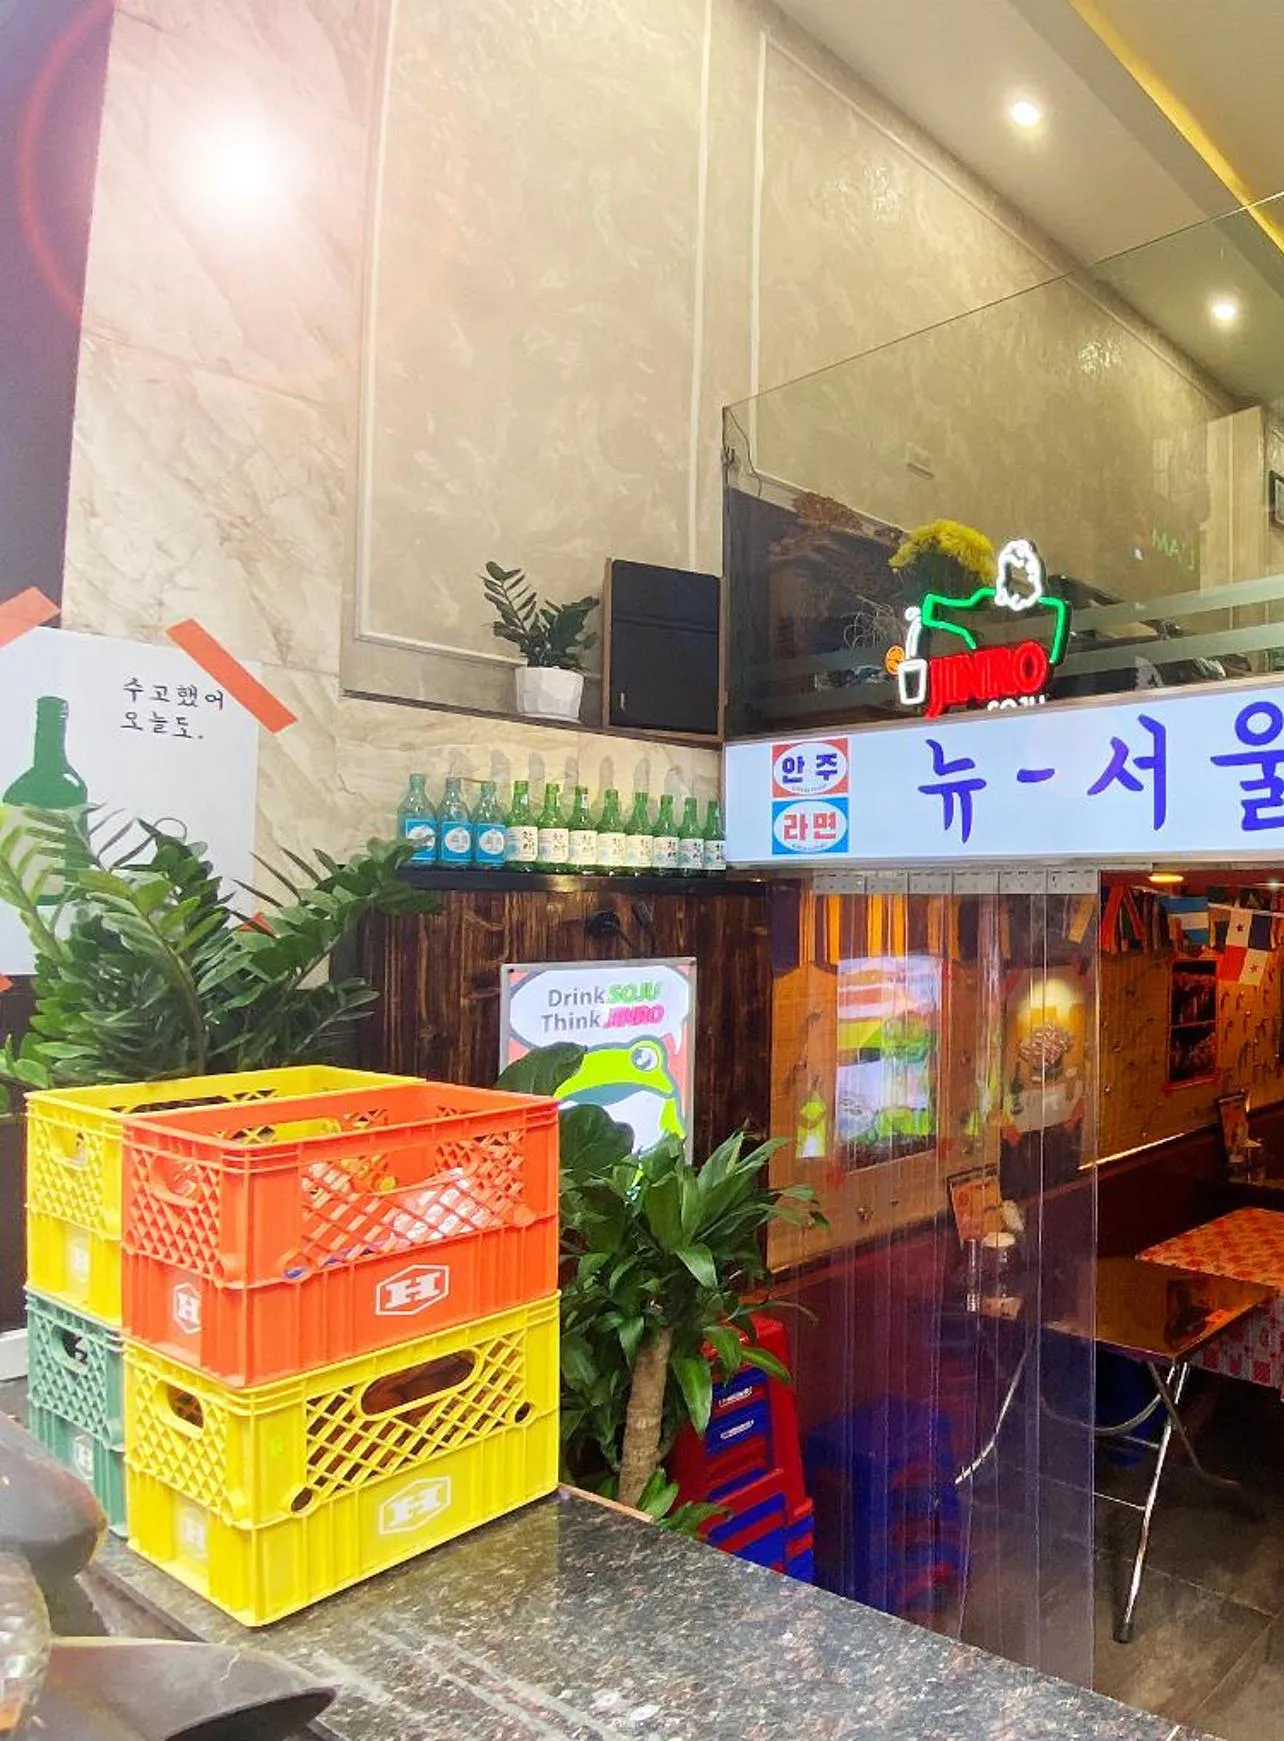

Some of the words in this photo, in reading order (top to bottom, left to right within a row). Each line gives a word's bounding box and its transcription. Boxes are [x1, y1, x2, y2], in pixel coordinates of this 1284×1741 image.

[123, 677, 224, 710] 수고했어
[922, 639, 1049, 720] JINRO
[120, 711, 204, 739] 오늘도.
[782, 752, 838, 784] 안주
[783, 811, 836, 841] 라면
[548, 986, 606, 1008] Drink
[541, 1010, 601, 1032] Think
